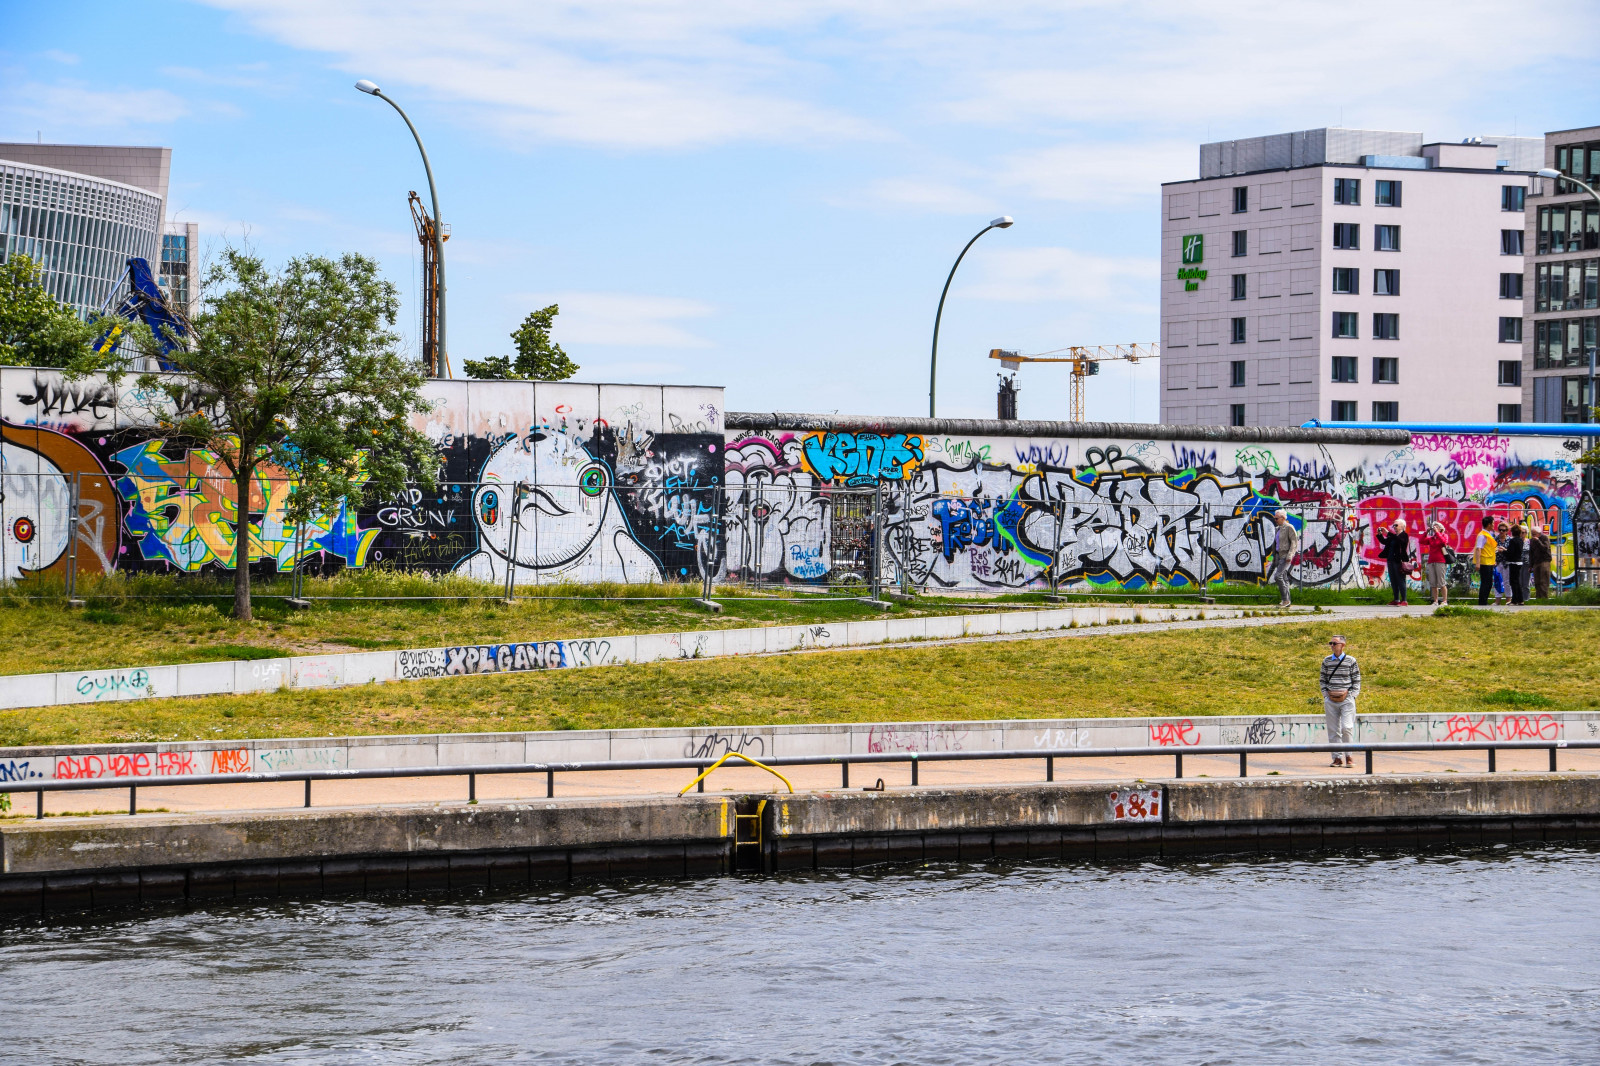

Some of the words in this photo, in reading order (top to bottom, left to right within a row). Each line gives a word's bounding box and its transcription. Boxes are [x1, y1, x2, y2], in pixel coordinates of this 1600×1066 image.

[1176, 267, 1208, 281] Holiday
[1184, 280, 1199, 292] Inn
[733, 429, 753, 443] WAVE
